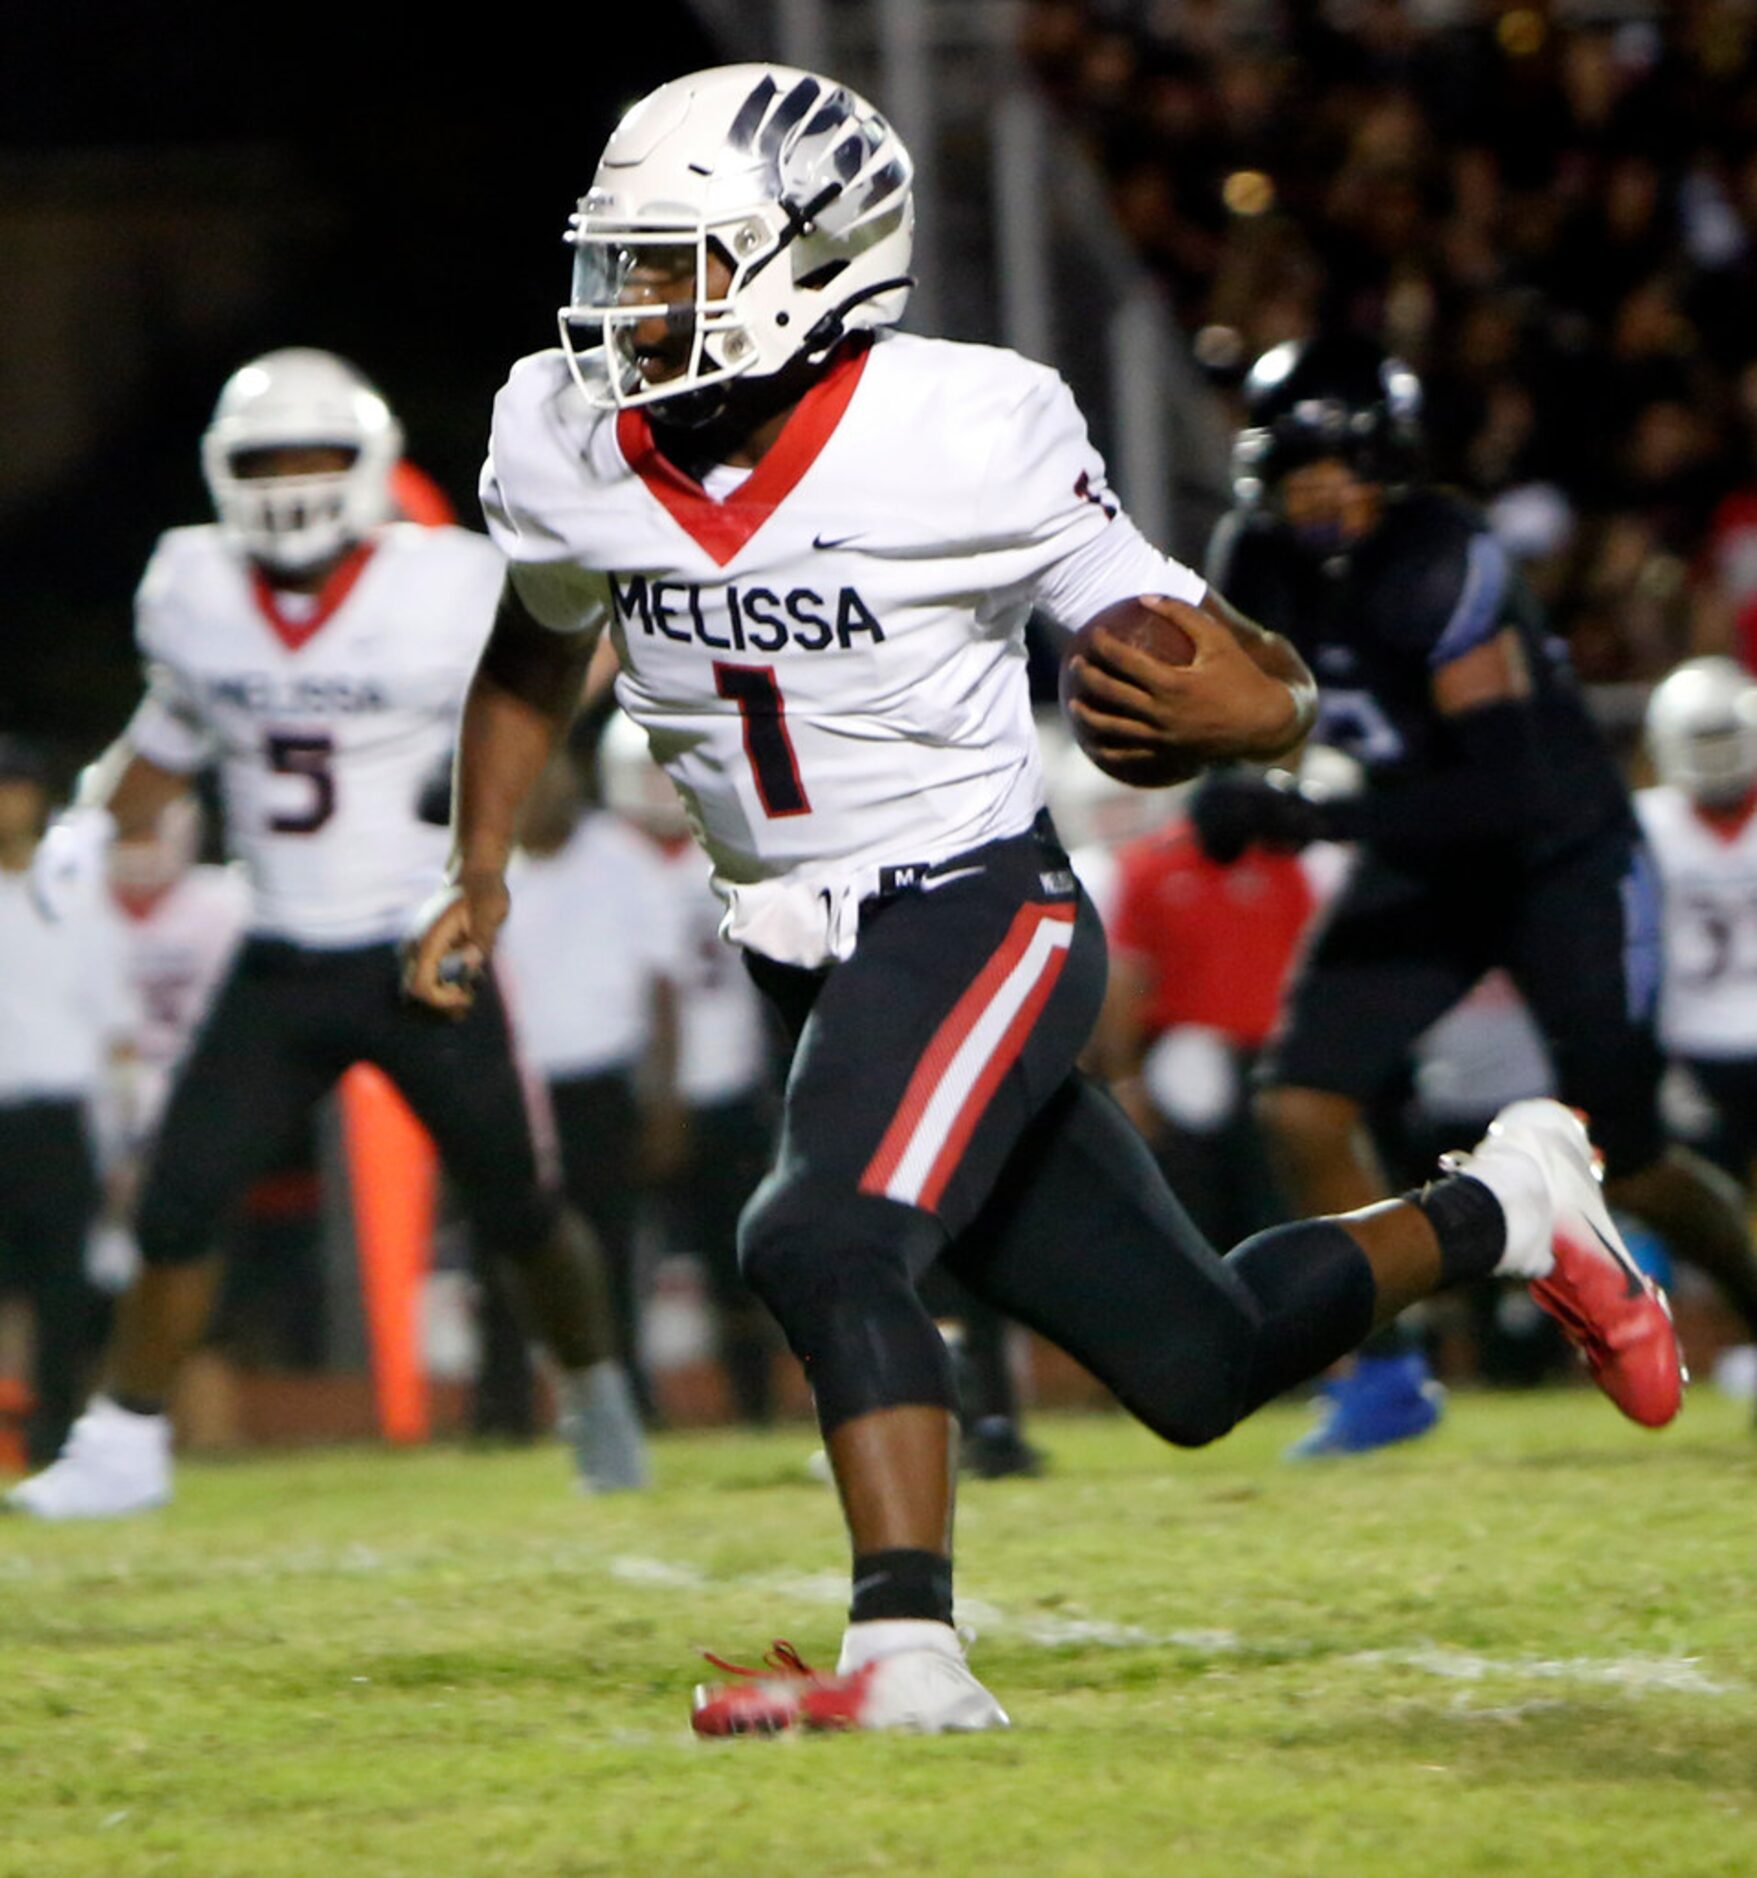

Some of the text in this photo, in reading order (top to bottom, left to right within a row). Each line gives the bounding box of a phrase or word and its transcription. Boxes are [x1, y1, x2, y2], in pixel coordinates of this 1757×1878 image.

[607, 571, 885, 652] MELISSA
[263, 728, 337, 837] 5
[711, 660, 813, 820] 1
[895, 867, 914, 887] M
